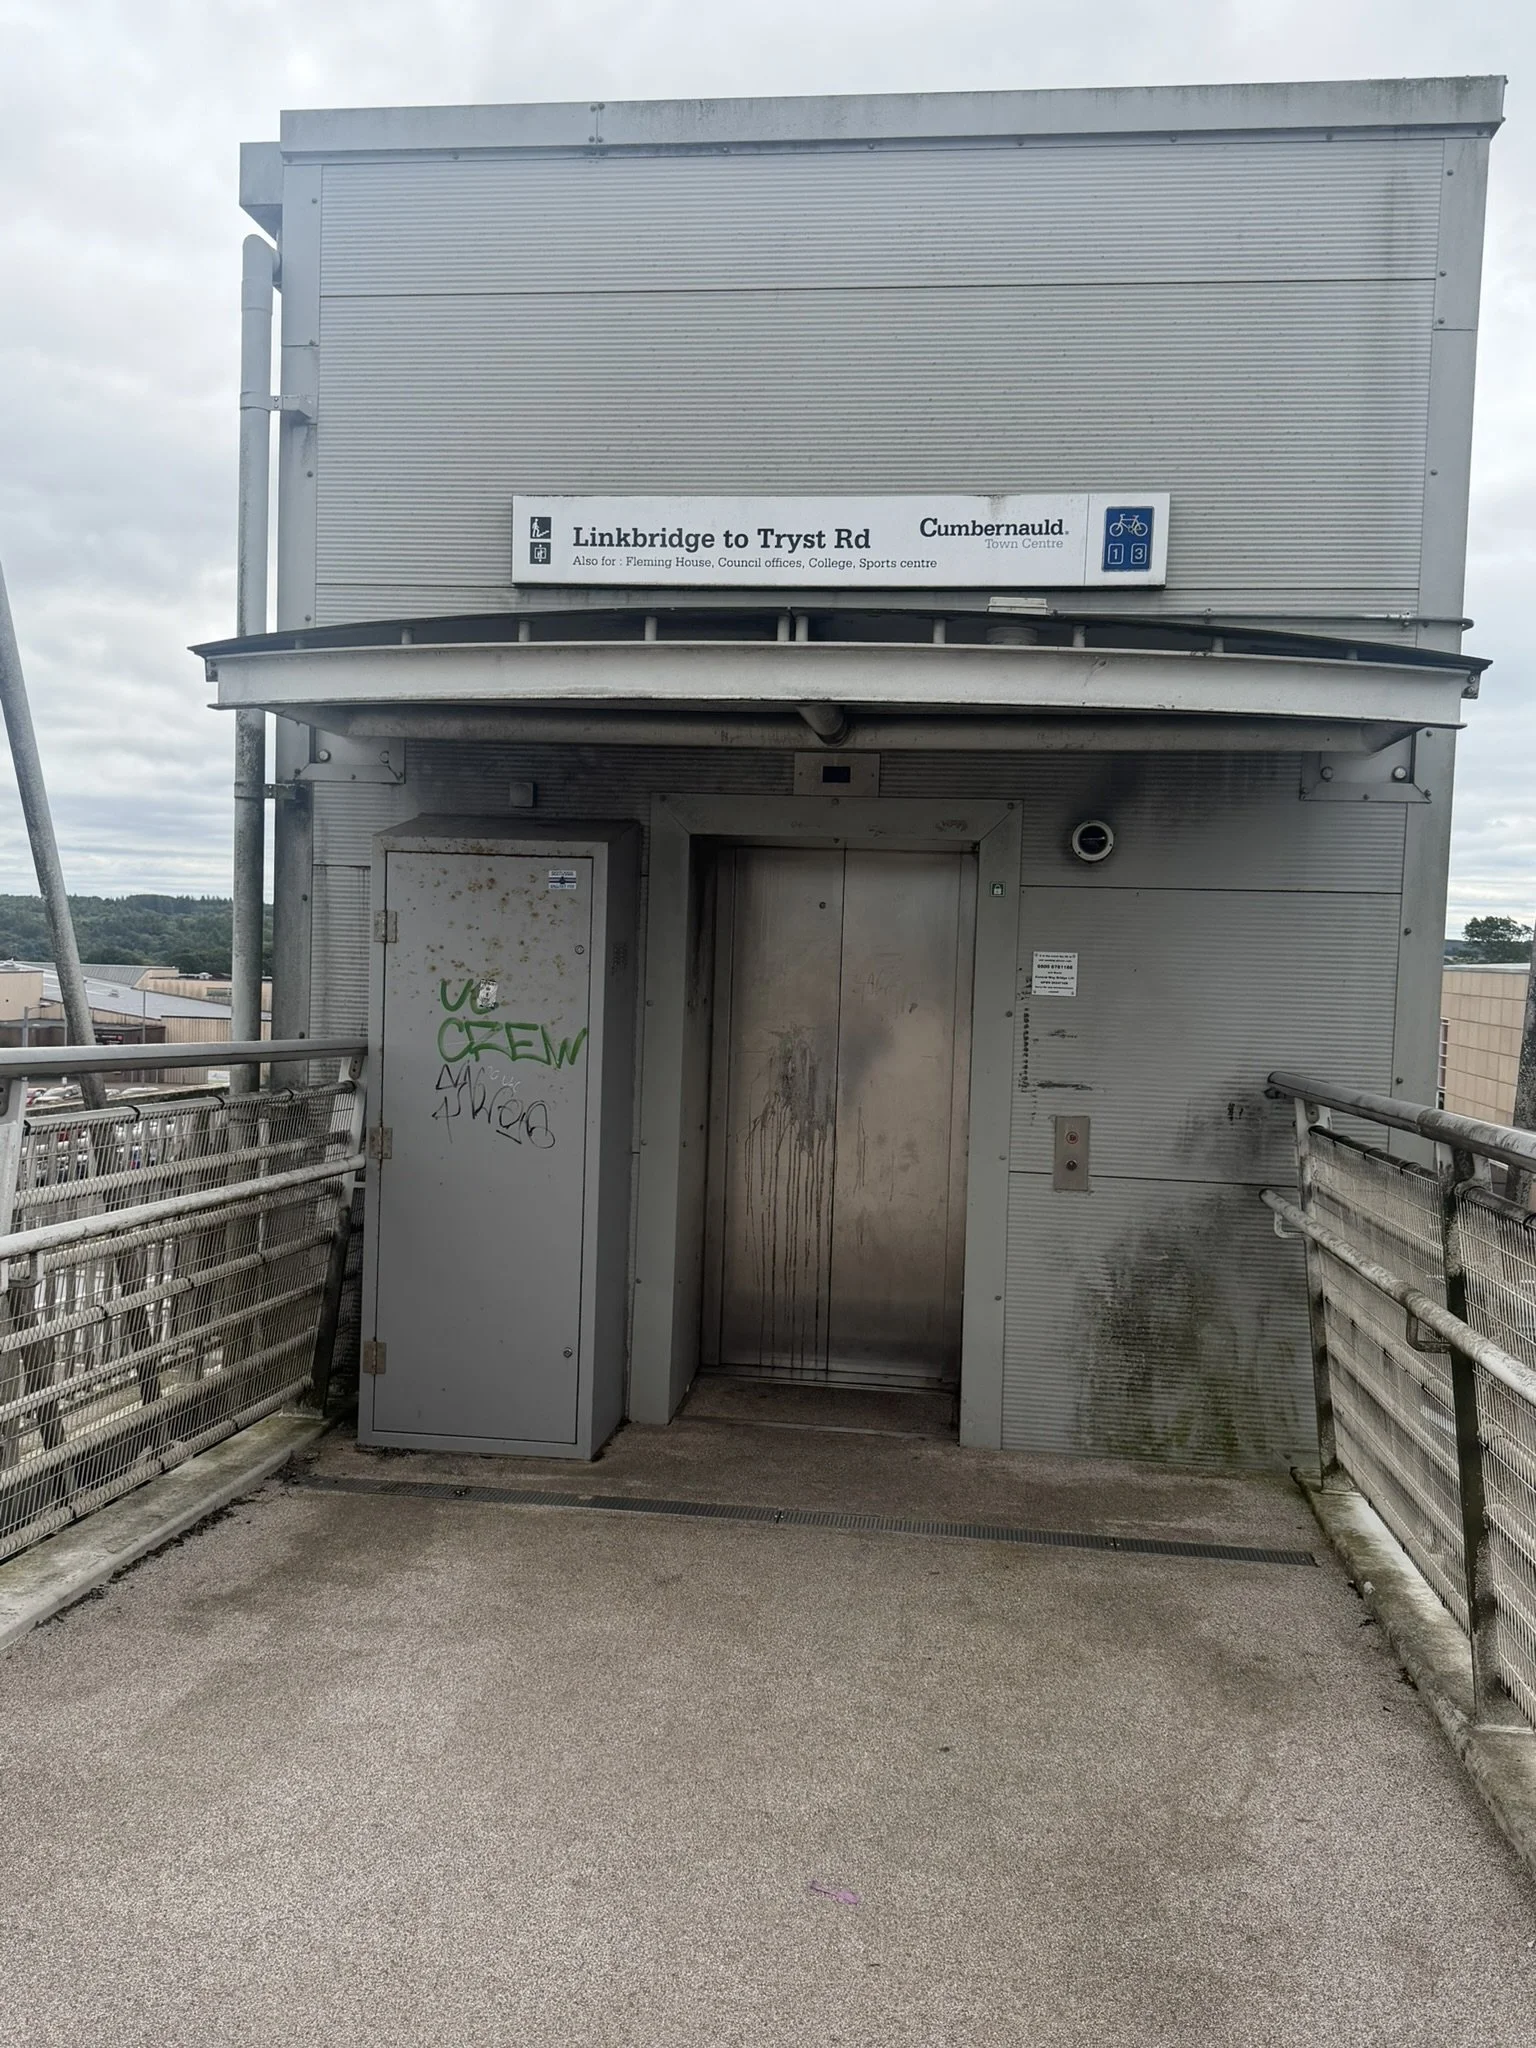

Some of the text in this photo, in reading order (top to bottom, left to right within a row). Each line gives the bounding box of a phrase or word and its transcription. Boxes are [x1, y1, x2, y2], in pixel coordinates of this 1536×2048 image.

[572, 526, 871, 554] Linkbridge to Tryst Rd
[985, 538, 1064, 549] Town Centre
[1112, 548, 1144, 560] 1 3
[572, 555, 599, 567] Also
[601, 555, 617, 567] for
[626, 556, 672, 570] Fleming
[675, 557, 714, 569] House,
[717, 556, 762, 568] Council
[764, 557, 805, 570] offices,
[808, 557, 856, 571] College,
[859, 558, 897, 571] Sports
[899, 559, 937, 568] centre
